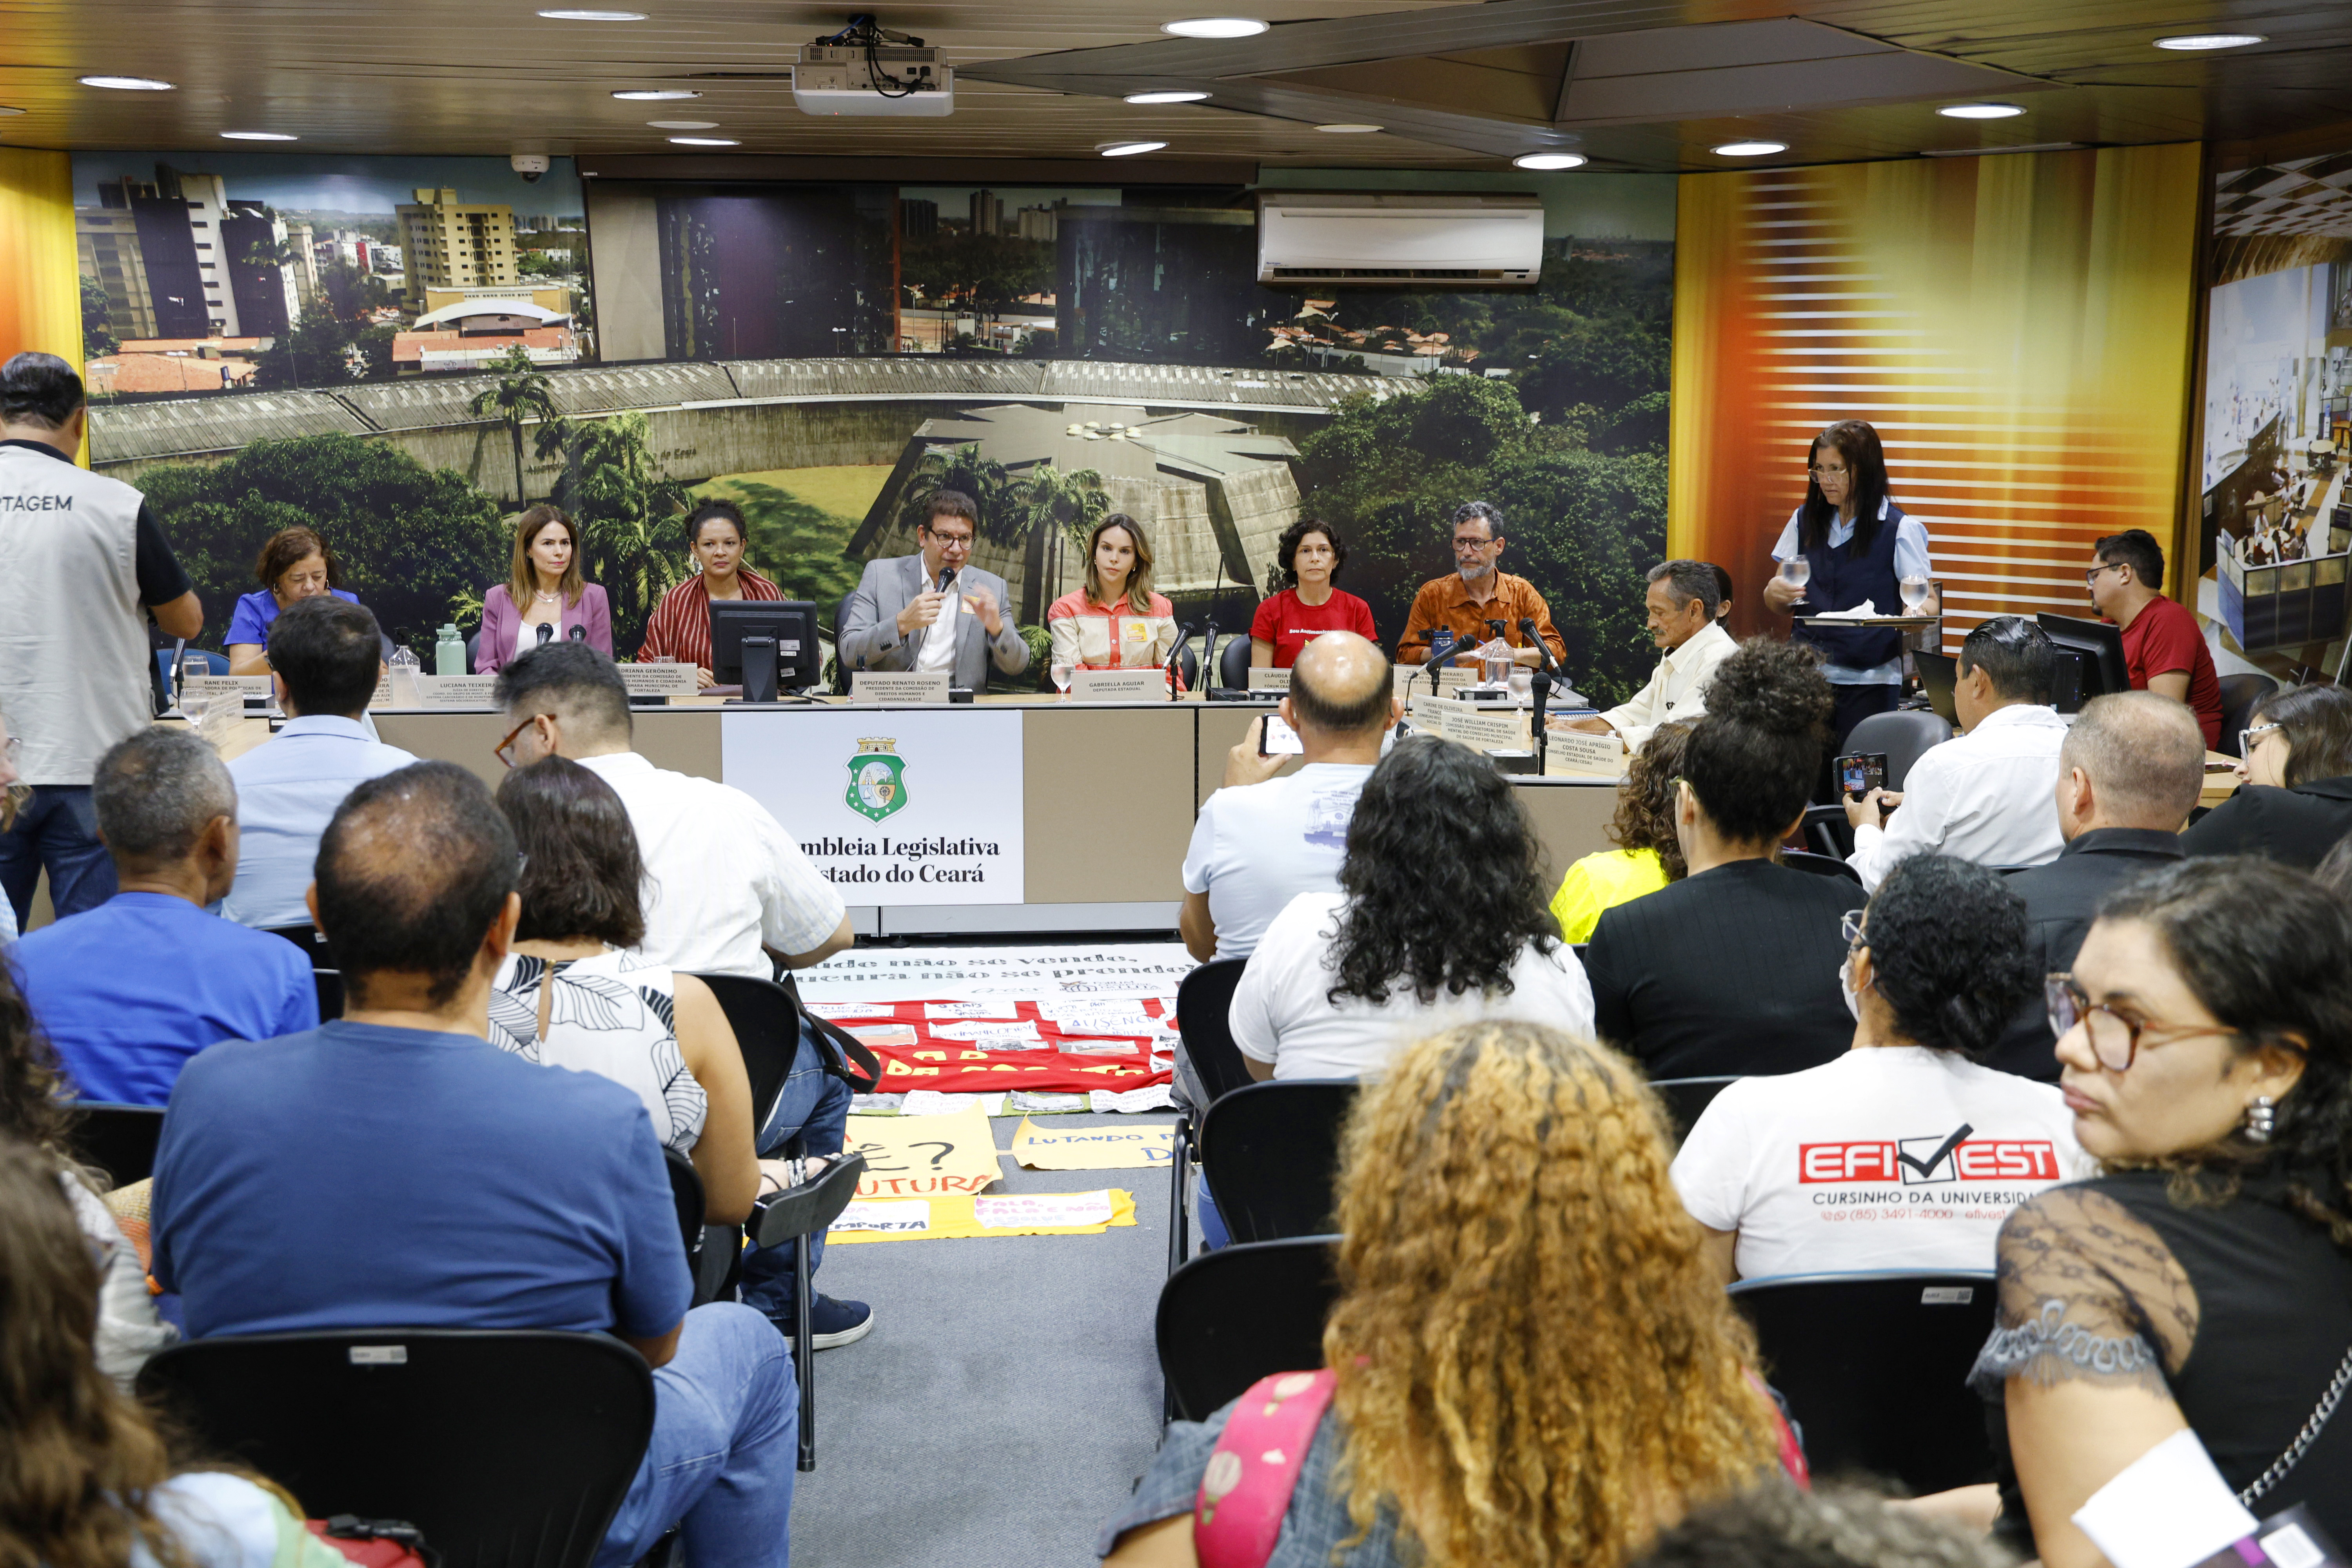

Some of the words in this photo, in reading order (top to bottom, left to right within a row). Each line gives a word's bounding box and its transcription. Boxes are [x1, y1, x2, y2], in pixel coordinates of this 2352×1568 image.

[0, 495, 73, 511] TAGEM
[1549, 736, 1574, 744] LEONARDO
[1589, 741, 1610, 750] APRÍGIO
[1565, 757, 1592, 765] CEARÁ/CESAU
[797, 837, 878, 856] mbleia
[882, 837, 1000, 862] Legislativa
[815, 864, 880, 883] stado
[886, 864, 914, 883] do
[919, 863, 985, 883] Ceará
[889, 958, 957, 967] não
[1017, 954, 1138, 965] vende,
[920, 970, 990, 980] não
[1028, 1134, 1144, 1145] LUTANDO
[1813, 1191, 1902, 1205] CURSINHO
[1910, 1191, 1934, 1204] DA
[1850, 1209, 1877, 1221] (85)
[1881, 1209, 1953, 1220] 3491-4000
[828, 1220, 926, 1230] MPORTA
